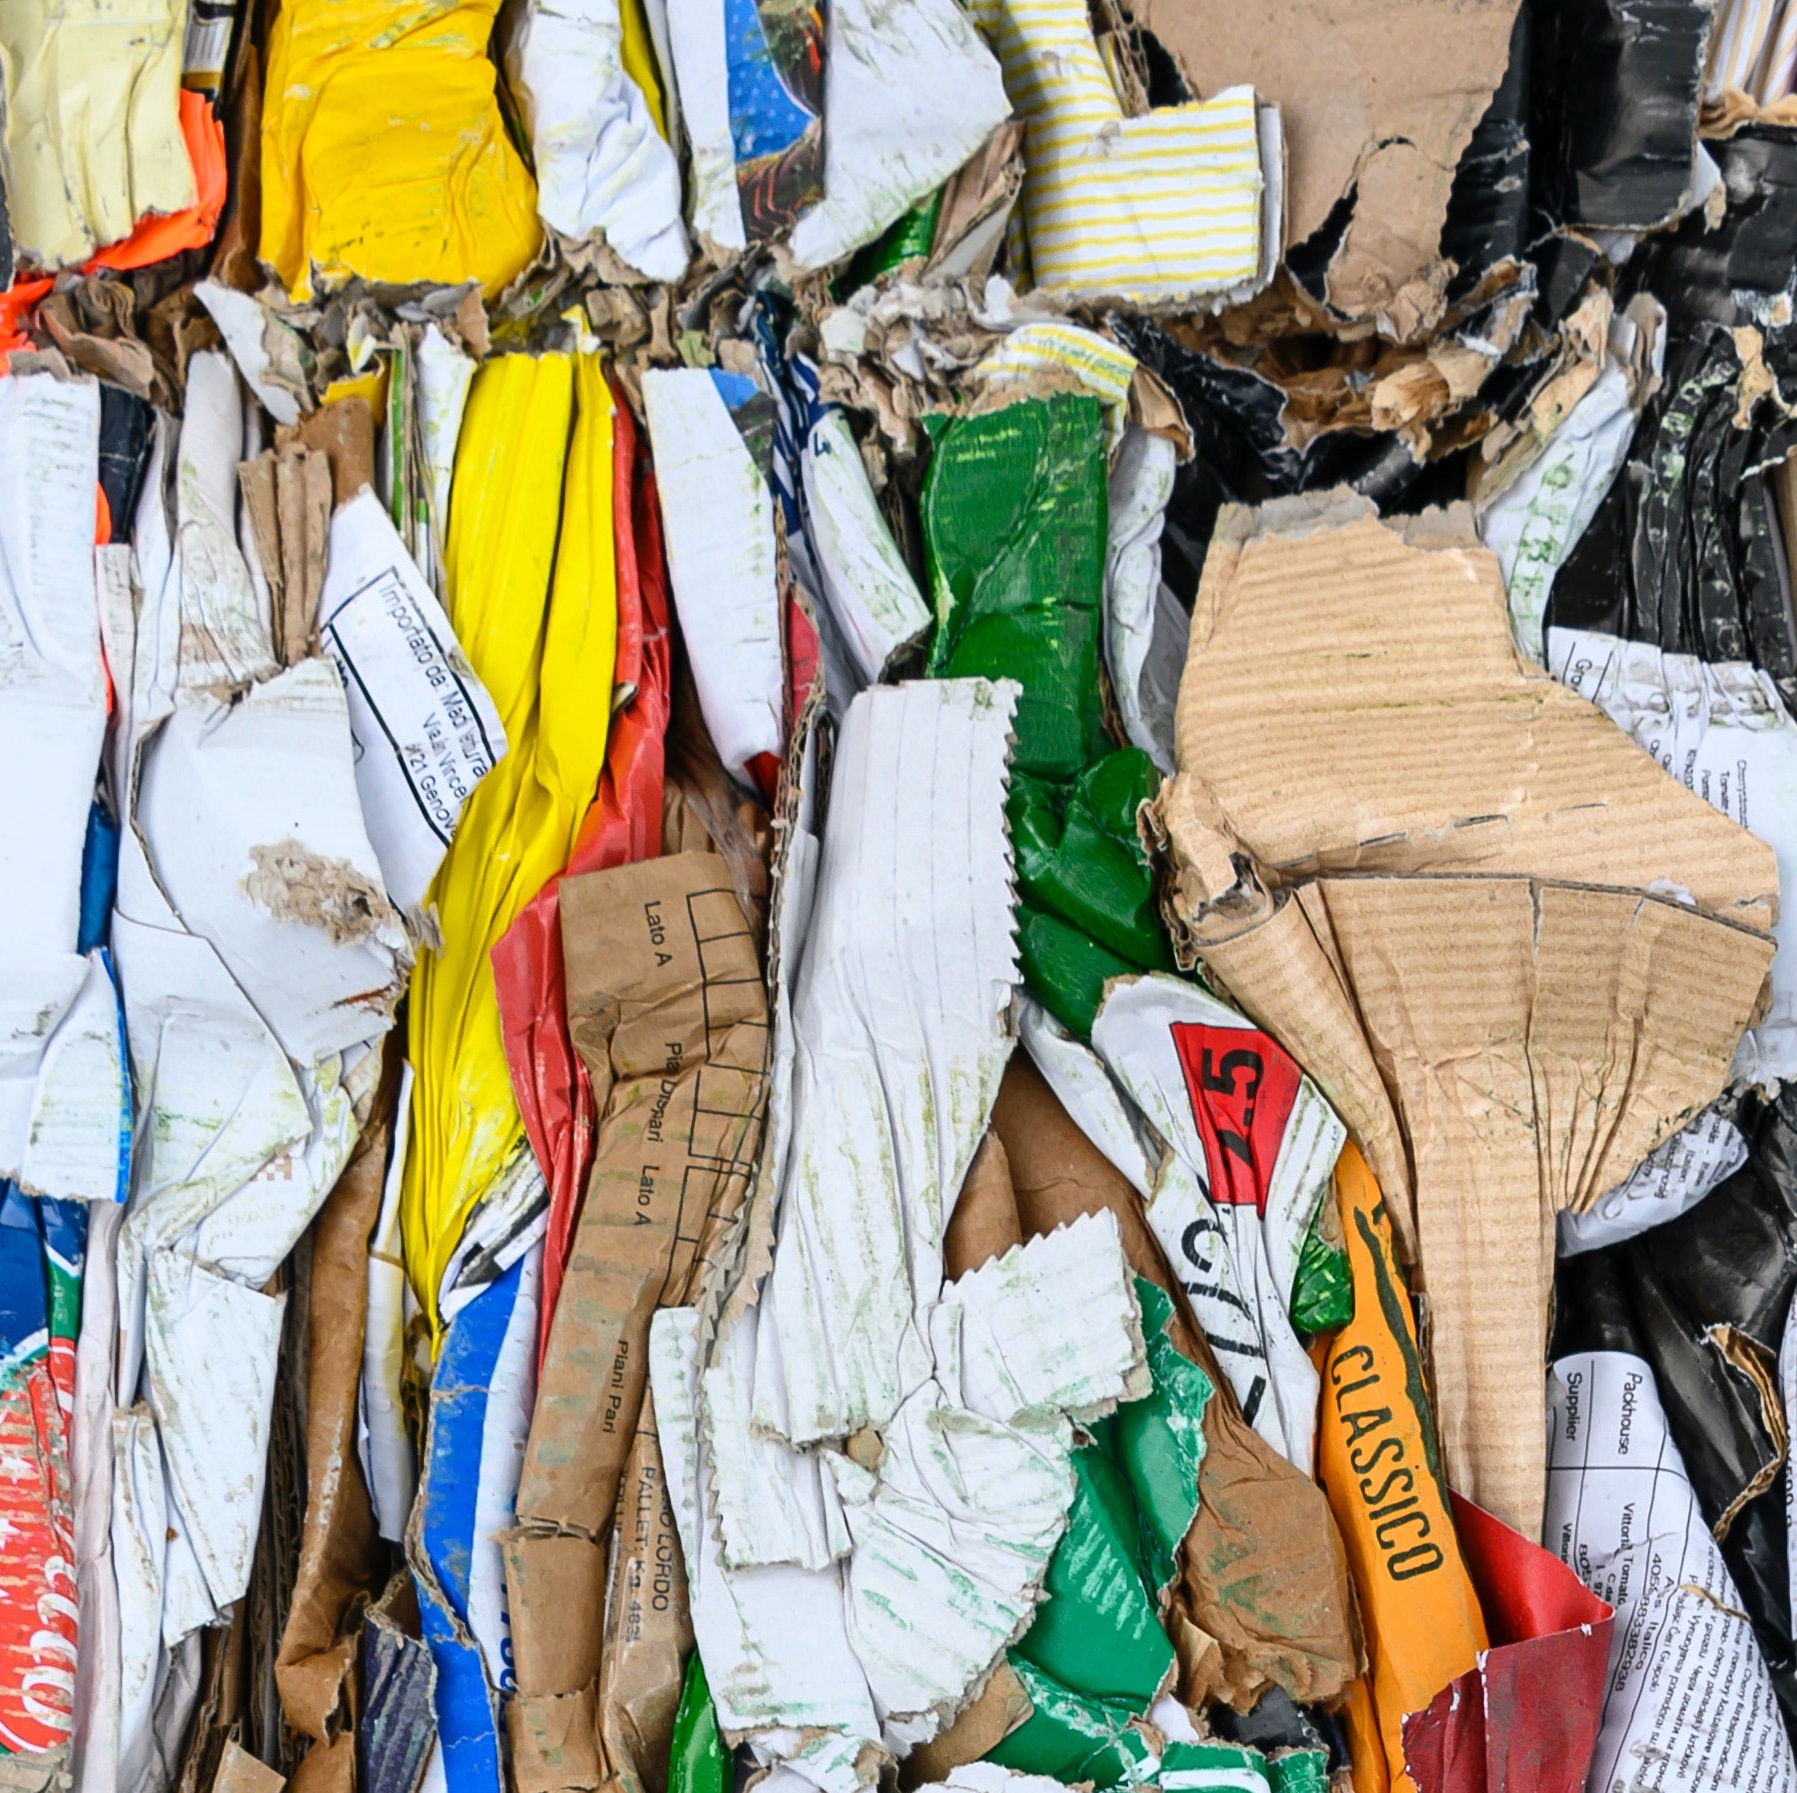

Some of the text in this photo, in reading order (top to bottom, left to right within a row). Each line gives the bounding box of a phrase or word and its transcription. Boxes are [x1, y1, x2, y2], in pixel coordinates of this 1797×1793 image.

[379, 582, 434, 666] Importato
[644, 900, 673, 968] Lato A
[633, 1164, 661, 1226] Lato A
[601, 1339, 630, 1434] Piani Pari
[1565, 1371, 1583, 1443] Supplier
[1617, 1372, 1643, 1456] Packhouse
[1331, 1344, 1445, 1583] CLASSICO
[634, 1465, 657, 1552] PALLET:
[1620, 1502, 1636, 1551] Vittoria
[651, 1532, 673, 1612] LORDO
[1635, 1621, 1660, 1671] Italico
